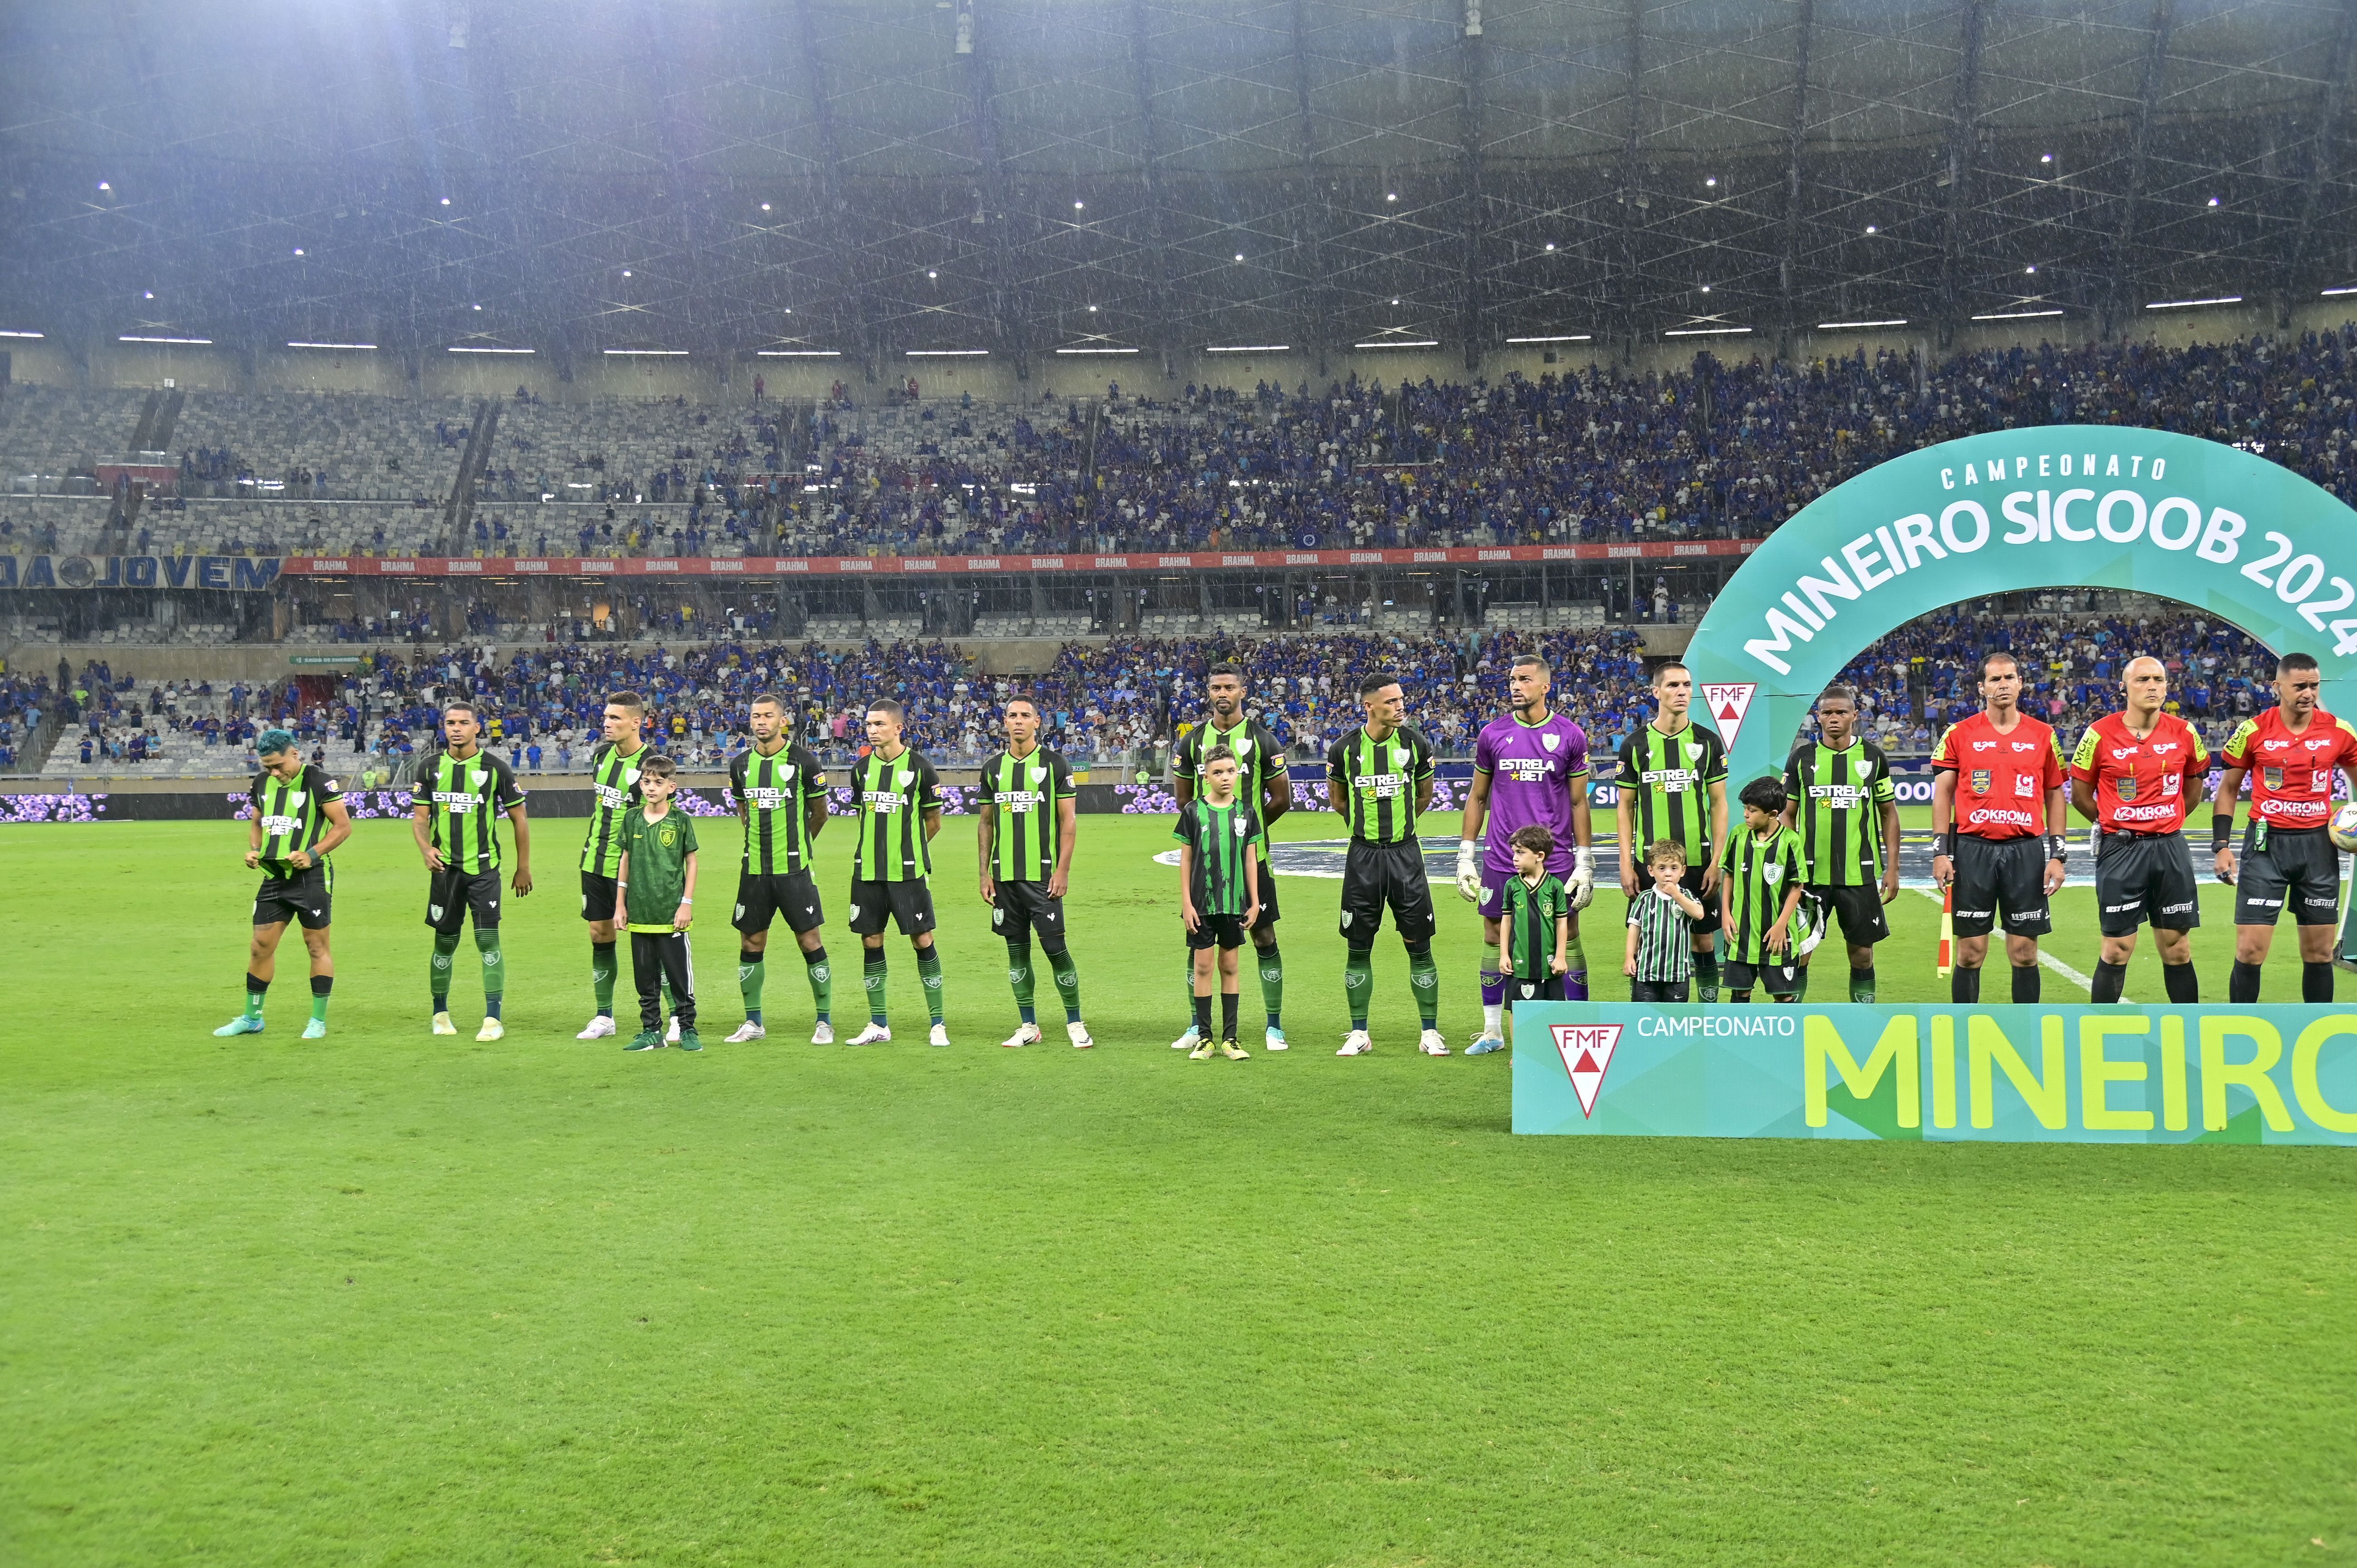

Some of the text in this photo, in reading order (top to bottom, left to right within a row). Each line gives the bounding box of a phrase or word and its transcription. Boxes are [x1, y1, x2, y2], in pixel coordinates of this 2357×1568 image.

[1940, 454, 2166, 490] CAMPEONATO
[313, 561, 348, 571] BRAHMA
[381, 561, 415, 571] BRAHMA
[448, 561, 482, 571] BRAHMA
[514, 561, 548, 571] BRAHMA
[581, 561, 615, 571] BRAHMA
[645, 561, 679, 571] BRAHMA
[711, 561, 743, 571] BRAHMA
[776, 561, 809, 571] BRAHMA
[840, 561, 873, 571] BRAHMA
[904, 560, 936, 570] BRAHMA
[968, 559, 1000, 569] BRAHMA
[1032, 558, 1064, 568] BRAHMA
[1095, 557, 1127, 567] BRAHMA
[1159, 557, 1191, 567] BRAHMA
[1222, 556, 1255, 566] BRAHMA
[1286, 554, 1318, 564] BRAHMA
[1350, 553, 1382, 563] BRAHMA
[1414, 552, 1446, 562] BRAHMA
[1478, 550, 1511, 560] BRAHMA
[1543, 549, 1576, 559] BRAHMA
[1608, 547, 1642, 557] BRAHMA
[1674, 545, 1707, 555] BRAHMA
[94, 556, 281, 590] JOVEM
[1743, 488, 2357, 676] MINEIRO SICOOB 2024
[1711, 687, 1746, 702] FMF
[1499, 758, 1555, 772] ESTRELA
[1355, 772, 1410, 788] ESTRELA
[1519, 770, 1545, 781] BET
[1642, 769, 1700, 784] ESTRELA
[1376, 784, 1401, 798] BET
[1664, 779, 1691, 793] BET
[1809, 785, 1870, 798] ESTRELA
[1875, 782, 1886, 794] C
[602, 795, 624, 809] BET
[994, 790, 1046, 803] ESTRELA
[1595, 786, 1620, 804] SI
[450, 802, 475, 813] BET
[758, 798, 782, 809] BET
[875, 802, 900, 814] BET
[1012, 801, 1035, 813] BET
[1831, 797, 1859, 809] BET
[2283, 801, 2327, 813] KRONA
[1989, 809, 2032, 823] KRONA
[271, 825, 294, 836] BET
[2304, 897, 2335, 906] OUTSIDER
[2162, 905, 2192, 913] OUTSIDER
[1637, 1016, 1795, 1036] CAMPEONATO
[1563, 1030, 1609, 1048] FMF
[1804, 1014, 2357, 1133] MINEIRO
